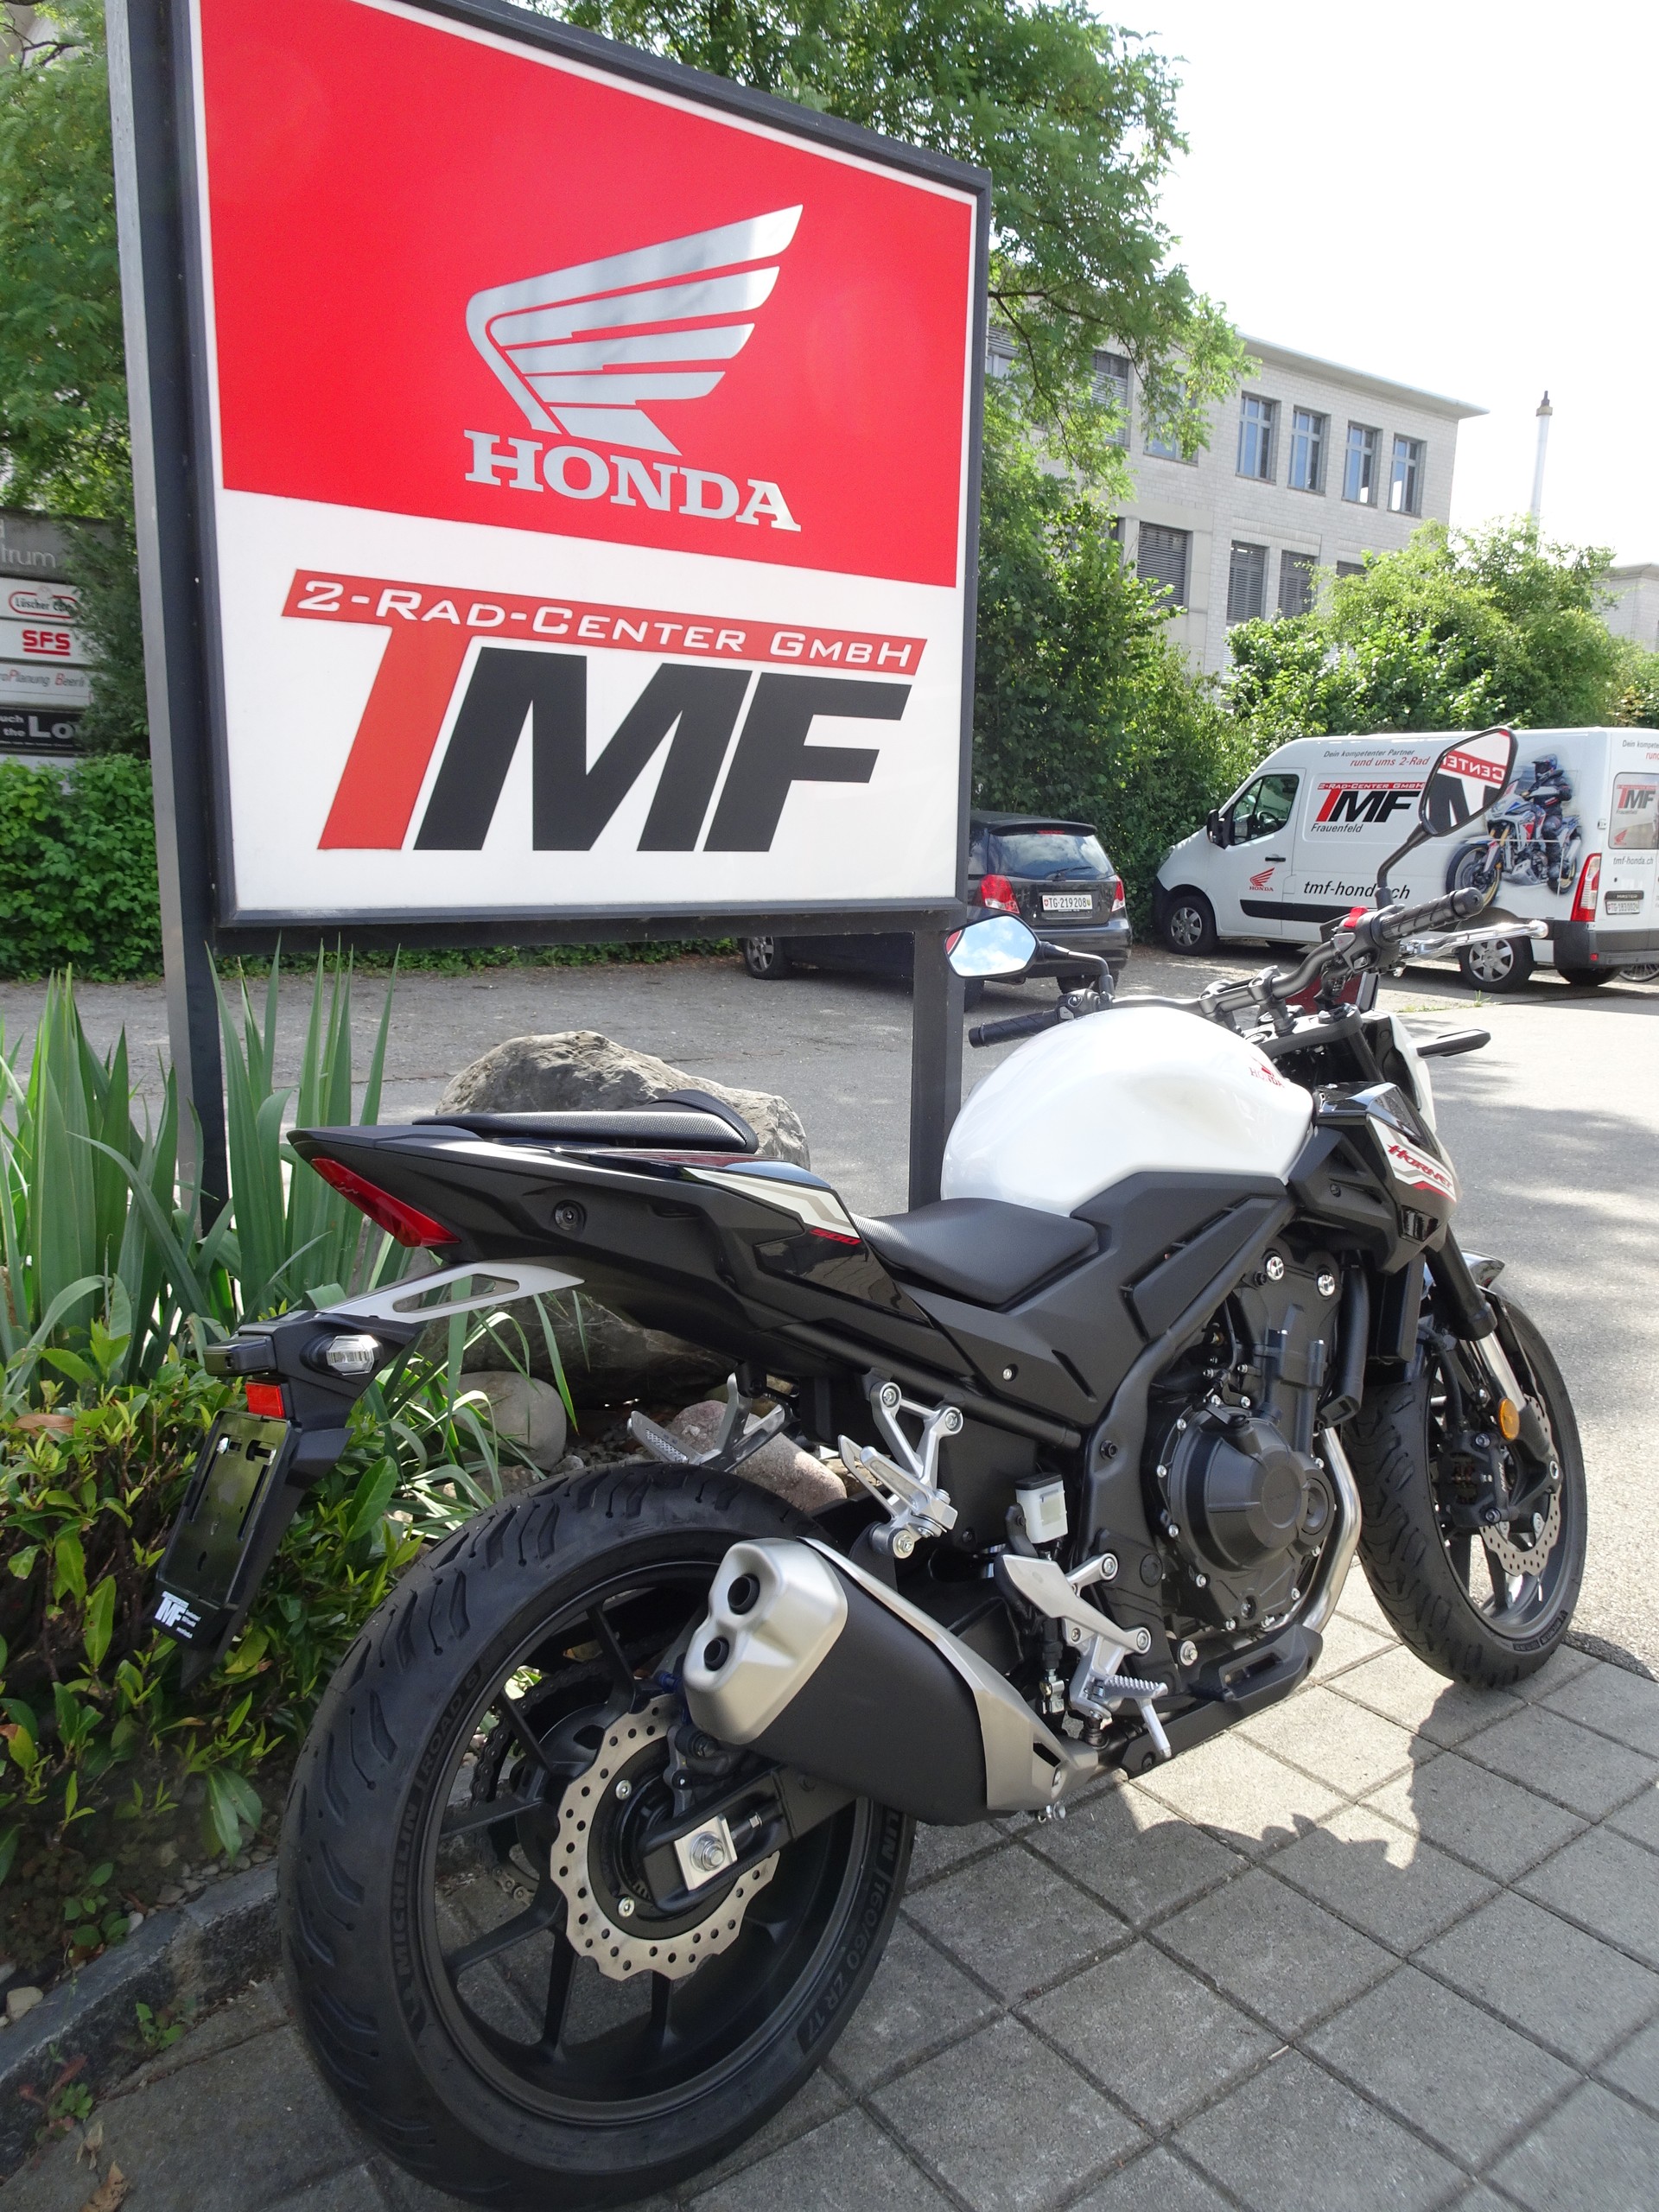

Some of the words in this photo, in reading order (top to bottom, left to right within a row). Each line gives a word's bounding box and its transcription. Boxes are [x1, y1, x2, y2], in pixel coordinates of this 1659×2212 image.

[463, 429, 802, 532] HONDA
[22, 629, 71, 651] SFS
[302, 596, 916, 852] TMF
[1350, 758, 1374, 767] rund
[1399, 756, 1431, 766] 2-Rad
[1316, 785, 1422, 822] TMF
[1617, 785, 1656, 809] TMF
[1311, 823, 1363, 833] Frauenfeld
[810, 1227, 862, 1246] 500
[389, 1802, 418, 1977] MICHELIN
